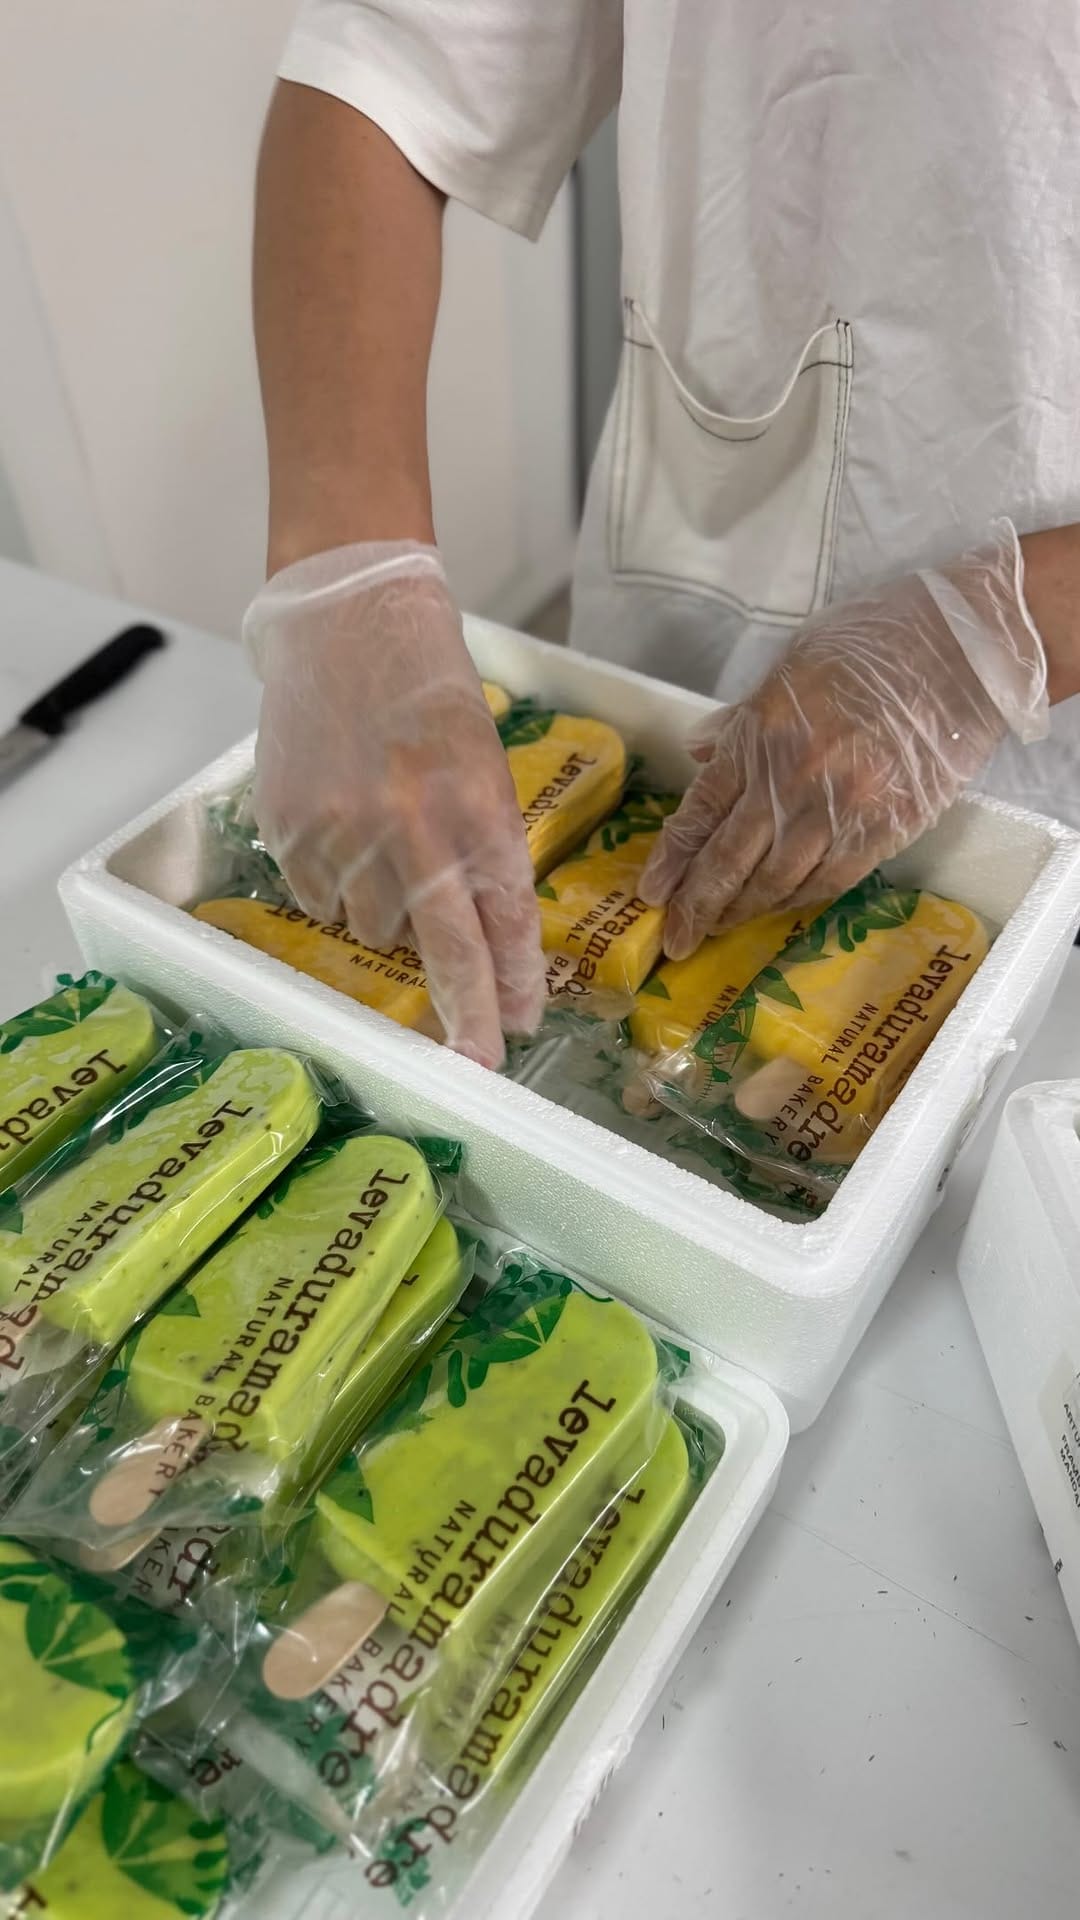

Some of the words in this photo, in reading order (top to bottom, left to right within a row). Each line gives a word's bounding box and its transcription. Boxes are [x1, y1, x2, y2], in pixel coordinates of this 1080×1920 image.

[522, 752, 597, 833] levadu
[565, 889, 625, 943] NATURAL
[349, 953, 428, 989] NATURAL
[786, 944, 971, 1163] levaduramadre
[820, 1002, 880, 1064] NATURAL
[0, 1049, 127, 1150] levad
[764, 1074, 825, 1146] BAKERY
[14, 1200, 109, 1292] NATURAL
[215, 1276, 295, 1382] NATURAL
[148, 1393, 216, 1498] BAKERY
[318, 1379, 617, 1788] levaduramadre
[385, 1499, 477, 1619] NATURAL
[295, 1635, 384, 1755] BAKERY
[365, 1486, 645, 1888] levaduramadre
